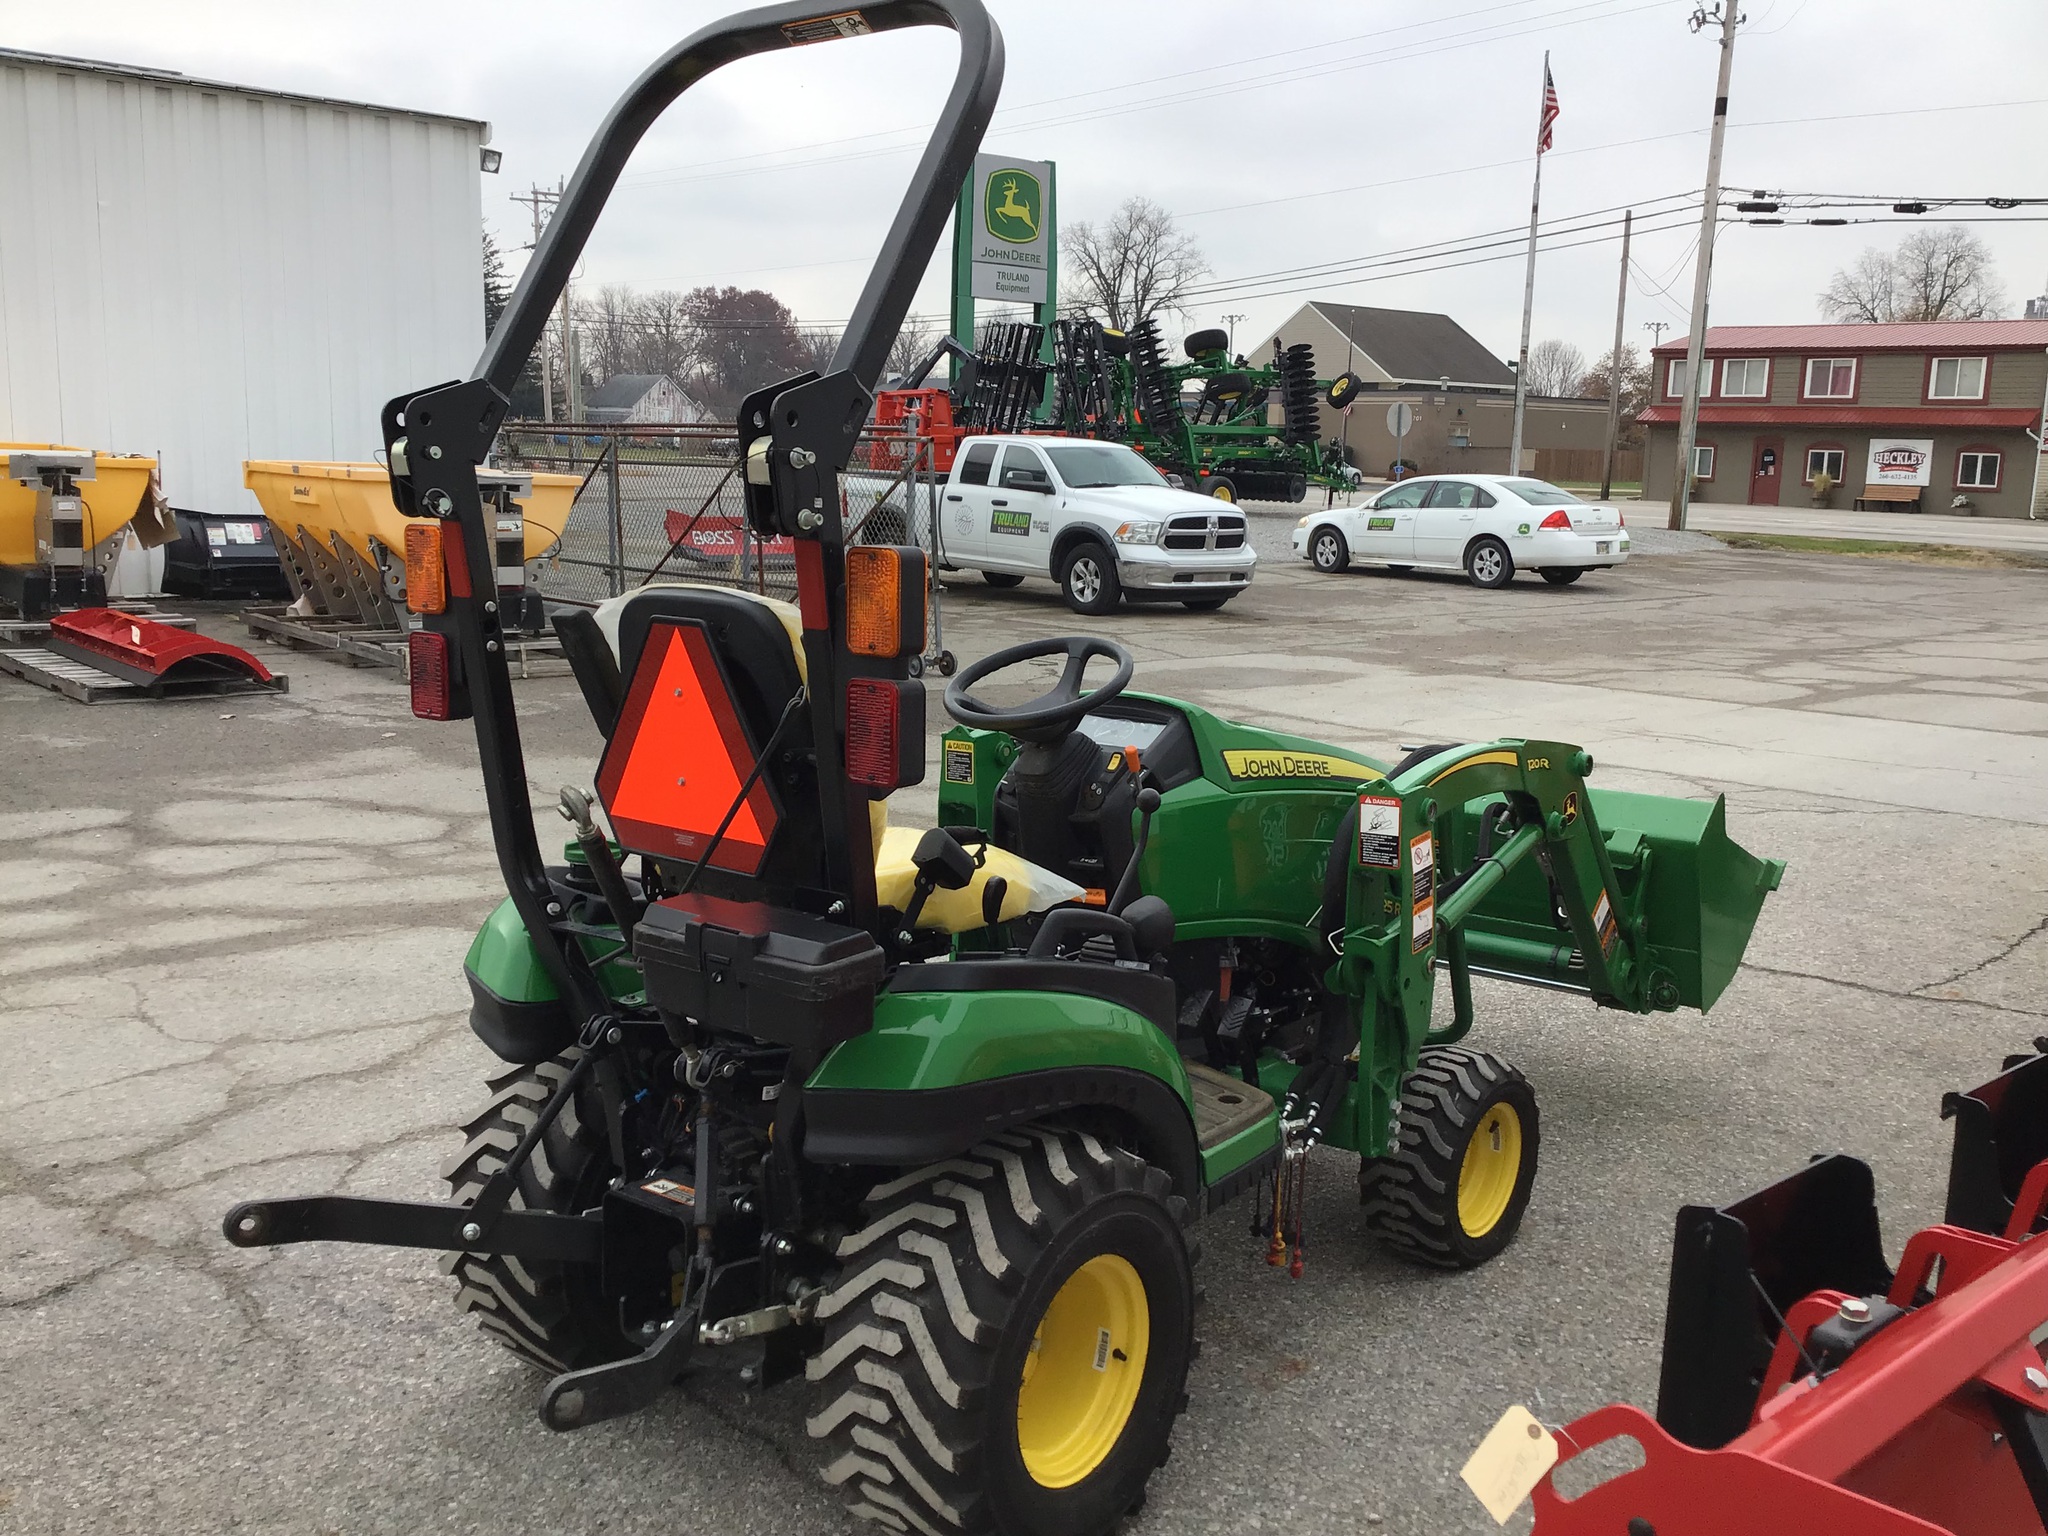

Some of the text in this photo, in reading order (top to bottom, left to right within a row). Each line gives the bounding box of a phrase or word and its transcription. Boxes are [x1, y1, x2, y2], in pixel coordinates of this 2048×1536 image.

[980, 246, 1042, 264] JOHN DEERE
[996, 271, 1030, 283] TRULAND
[995, 281, 1031, 294] Equipment
[1874, 451, 1926, 465] HECKLEY
[993, 511, 1030, 528] TRULAND
[997, 526, 1025, 535] EQUIPMENT
[692, 530, 735, 545] BOSS
[952, 742, 973, 751] CAUTION
[1240, 756, 1332, 776] JOHN DEERE
[1372, 798, 1396, 806] DANGER
